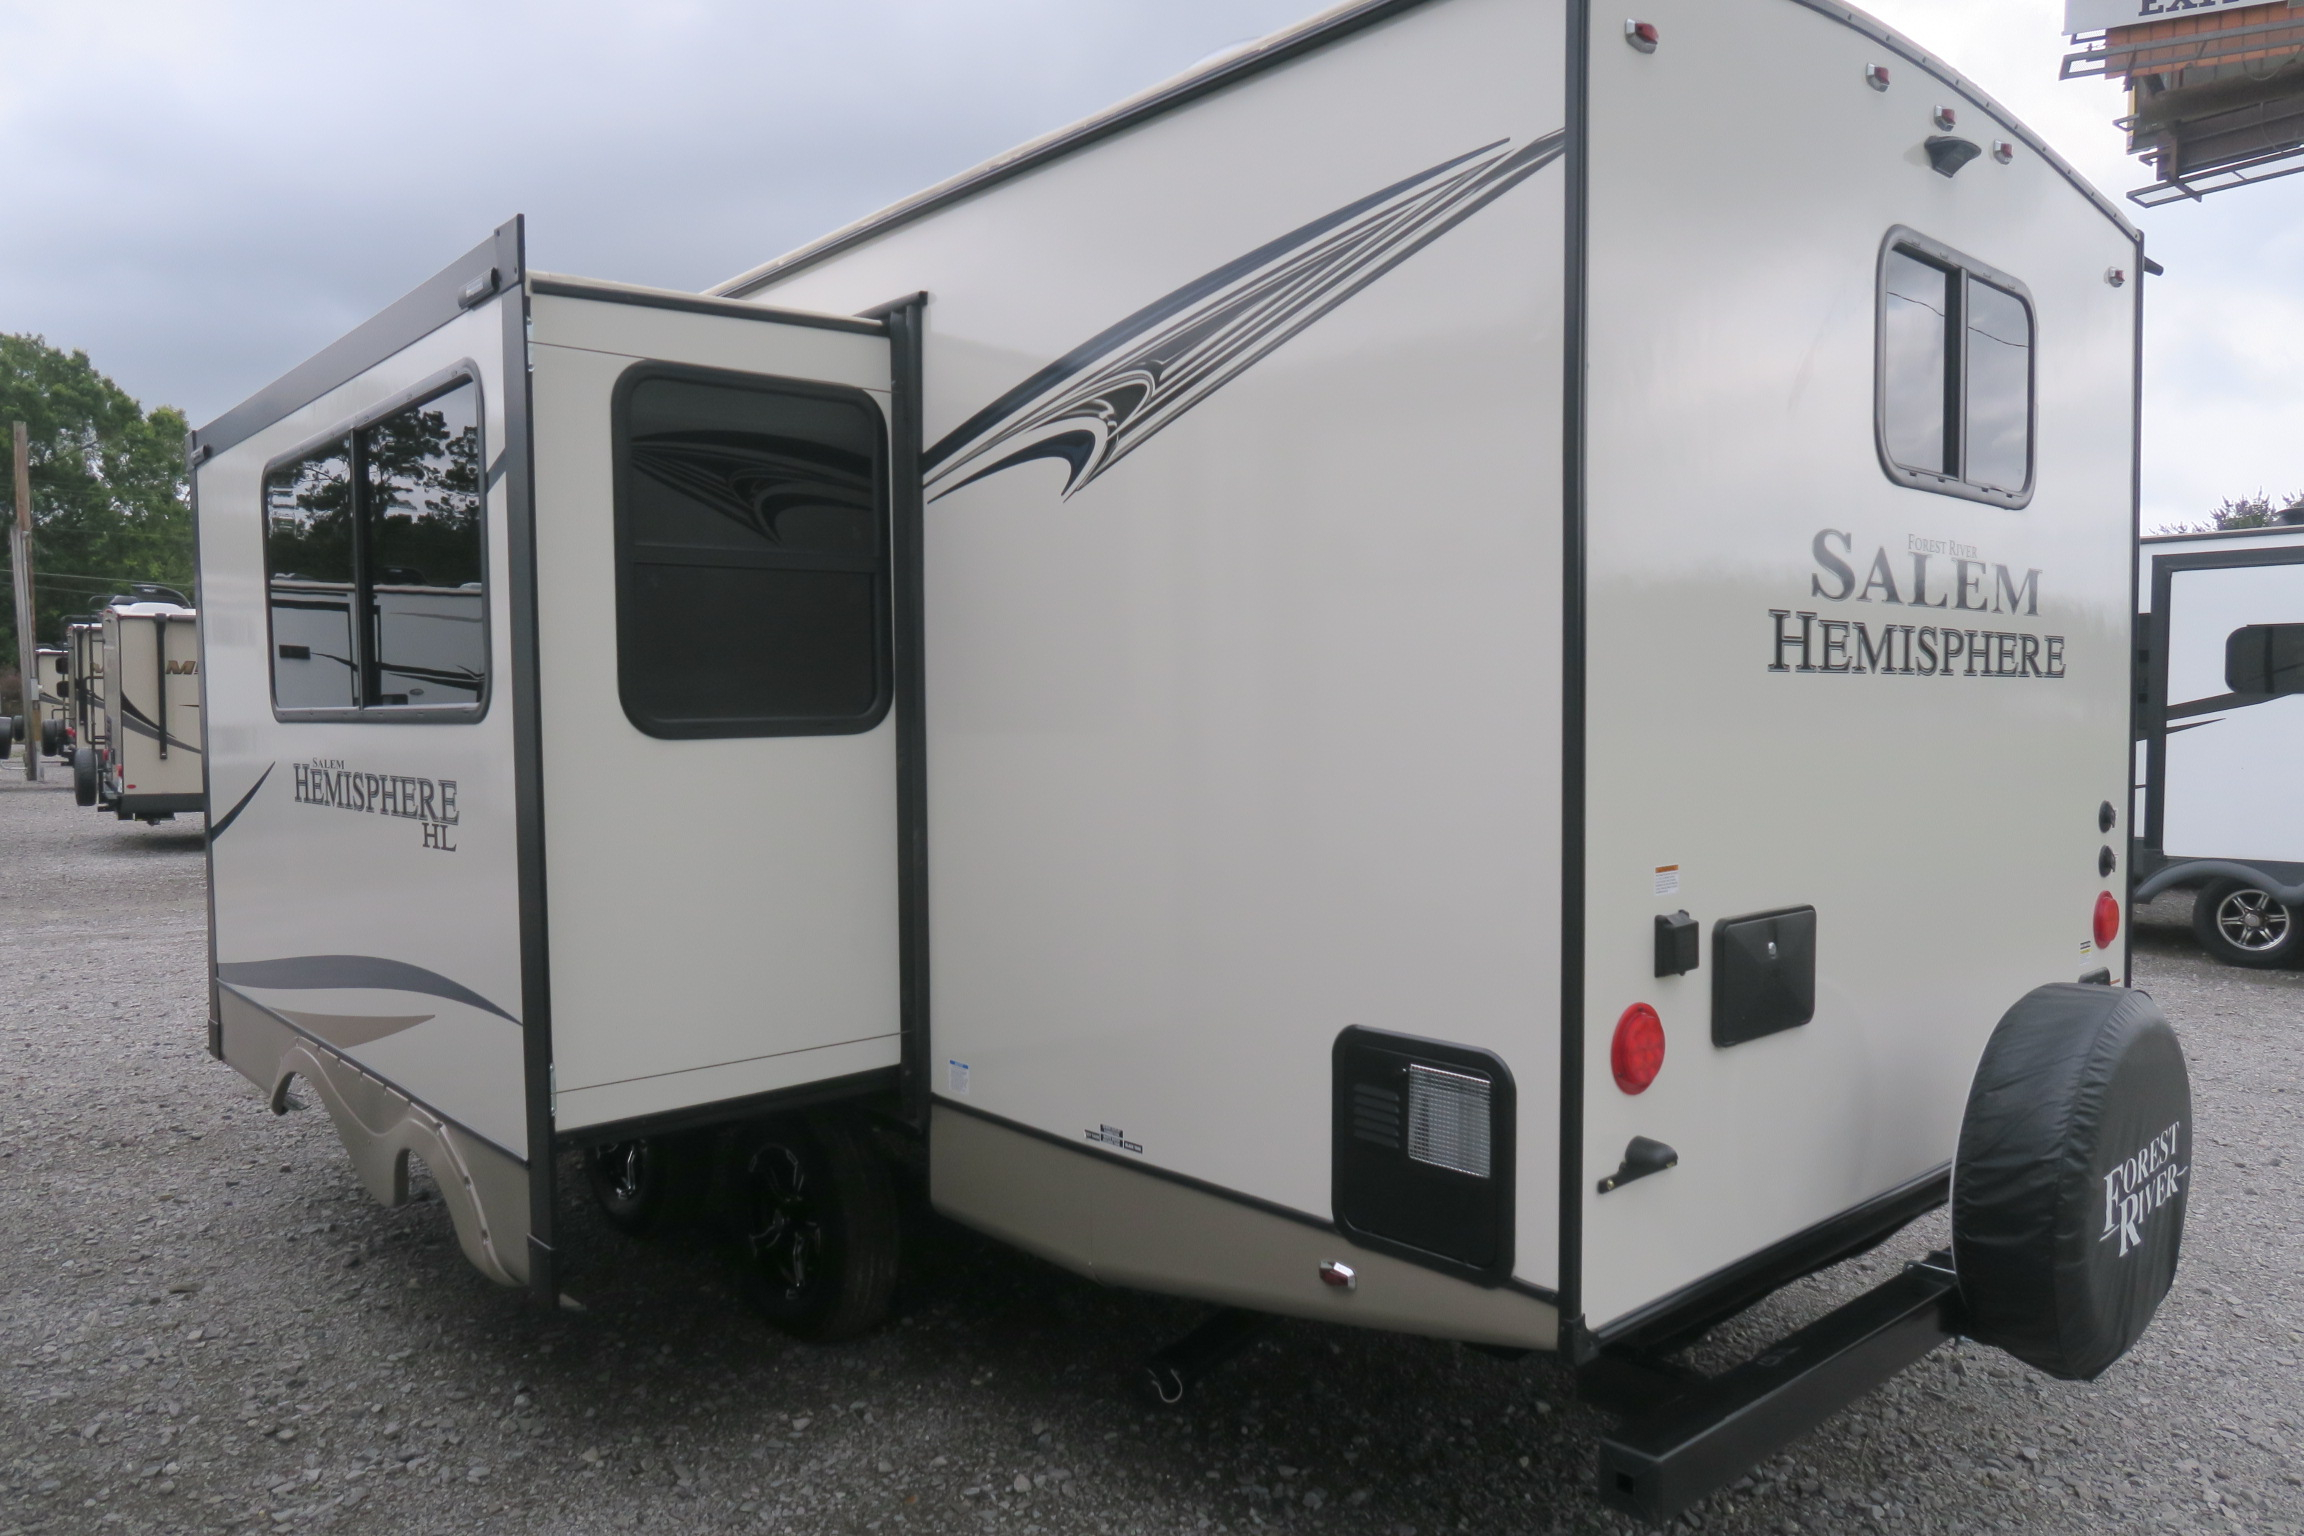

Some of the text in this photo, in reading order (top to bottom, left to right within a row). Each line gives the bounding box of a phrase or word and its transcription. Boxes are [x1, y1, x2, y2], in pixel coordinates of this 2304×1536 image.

[1811, 528, 2043, 617] SALEM
[1908, 533, 1978, 559] FOREST RIVER
[1767, 608, 2067, 678] HEMISPHERE
[293, 763, 460, 826] HEMISPHERE
[312, 757, 345, 770] SALEM
[422, 822, 457, 852] HL
[2103, 1121, 2180, 1233] FOREST
[2118, 1163, 2180, 1258] RIVER
